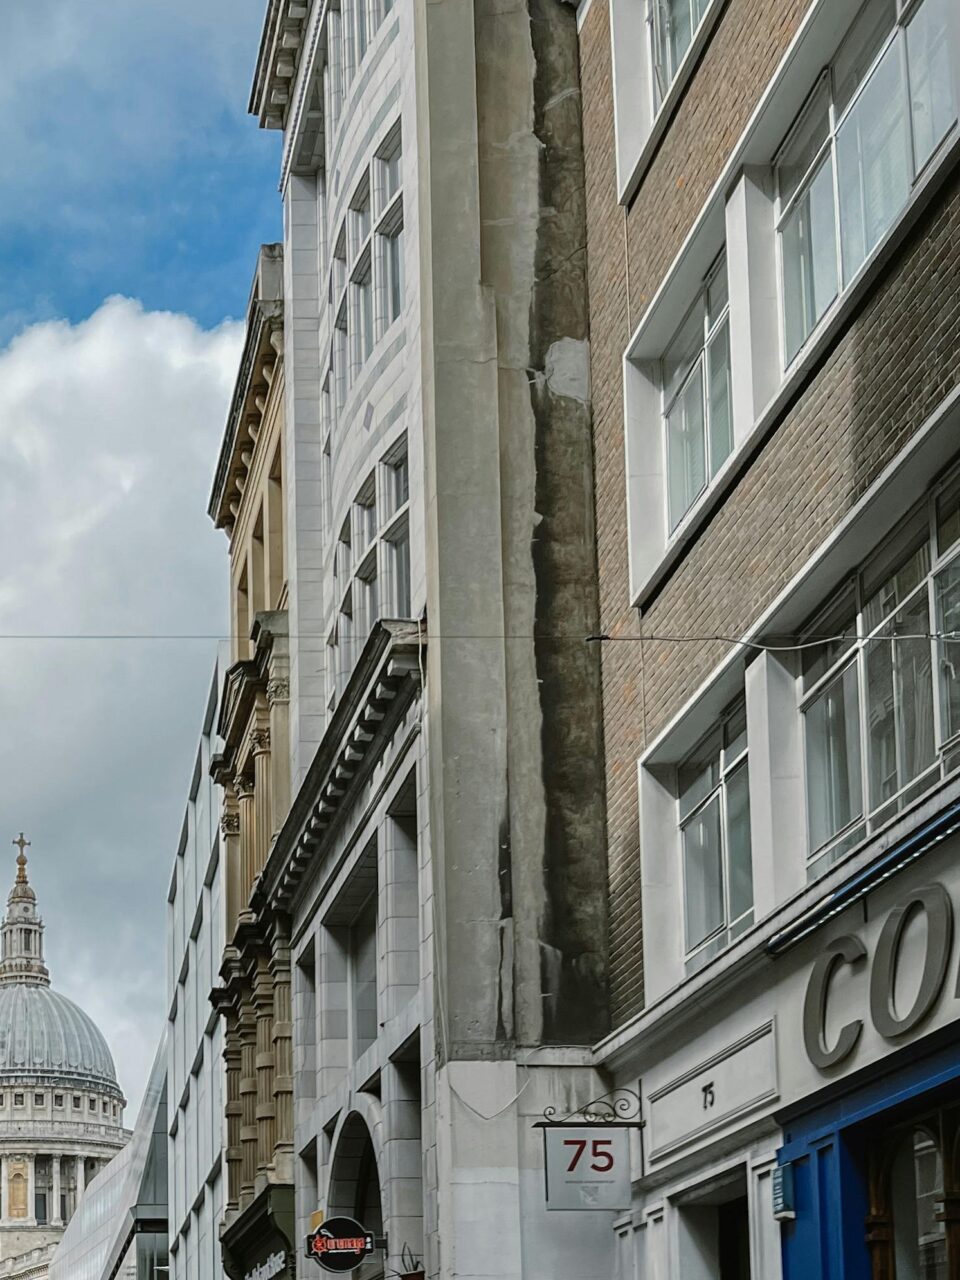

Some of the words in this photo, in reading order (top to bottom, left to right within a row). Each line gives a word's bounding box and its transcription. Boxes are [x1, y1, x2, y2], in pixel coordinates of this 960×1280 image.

[803, 880, 960, 1069] CO
[701, 1081, 715, 1111] 75
[563, 1139, 614, 1172] 75
